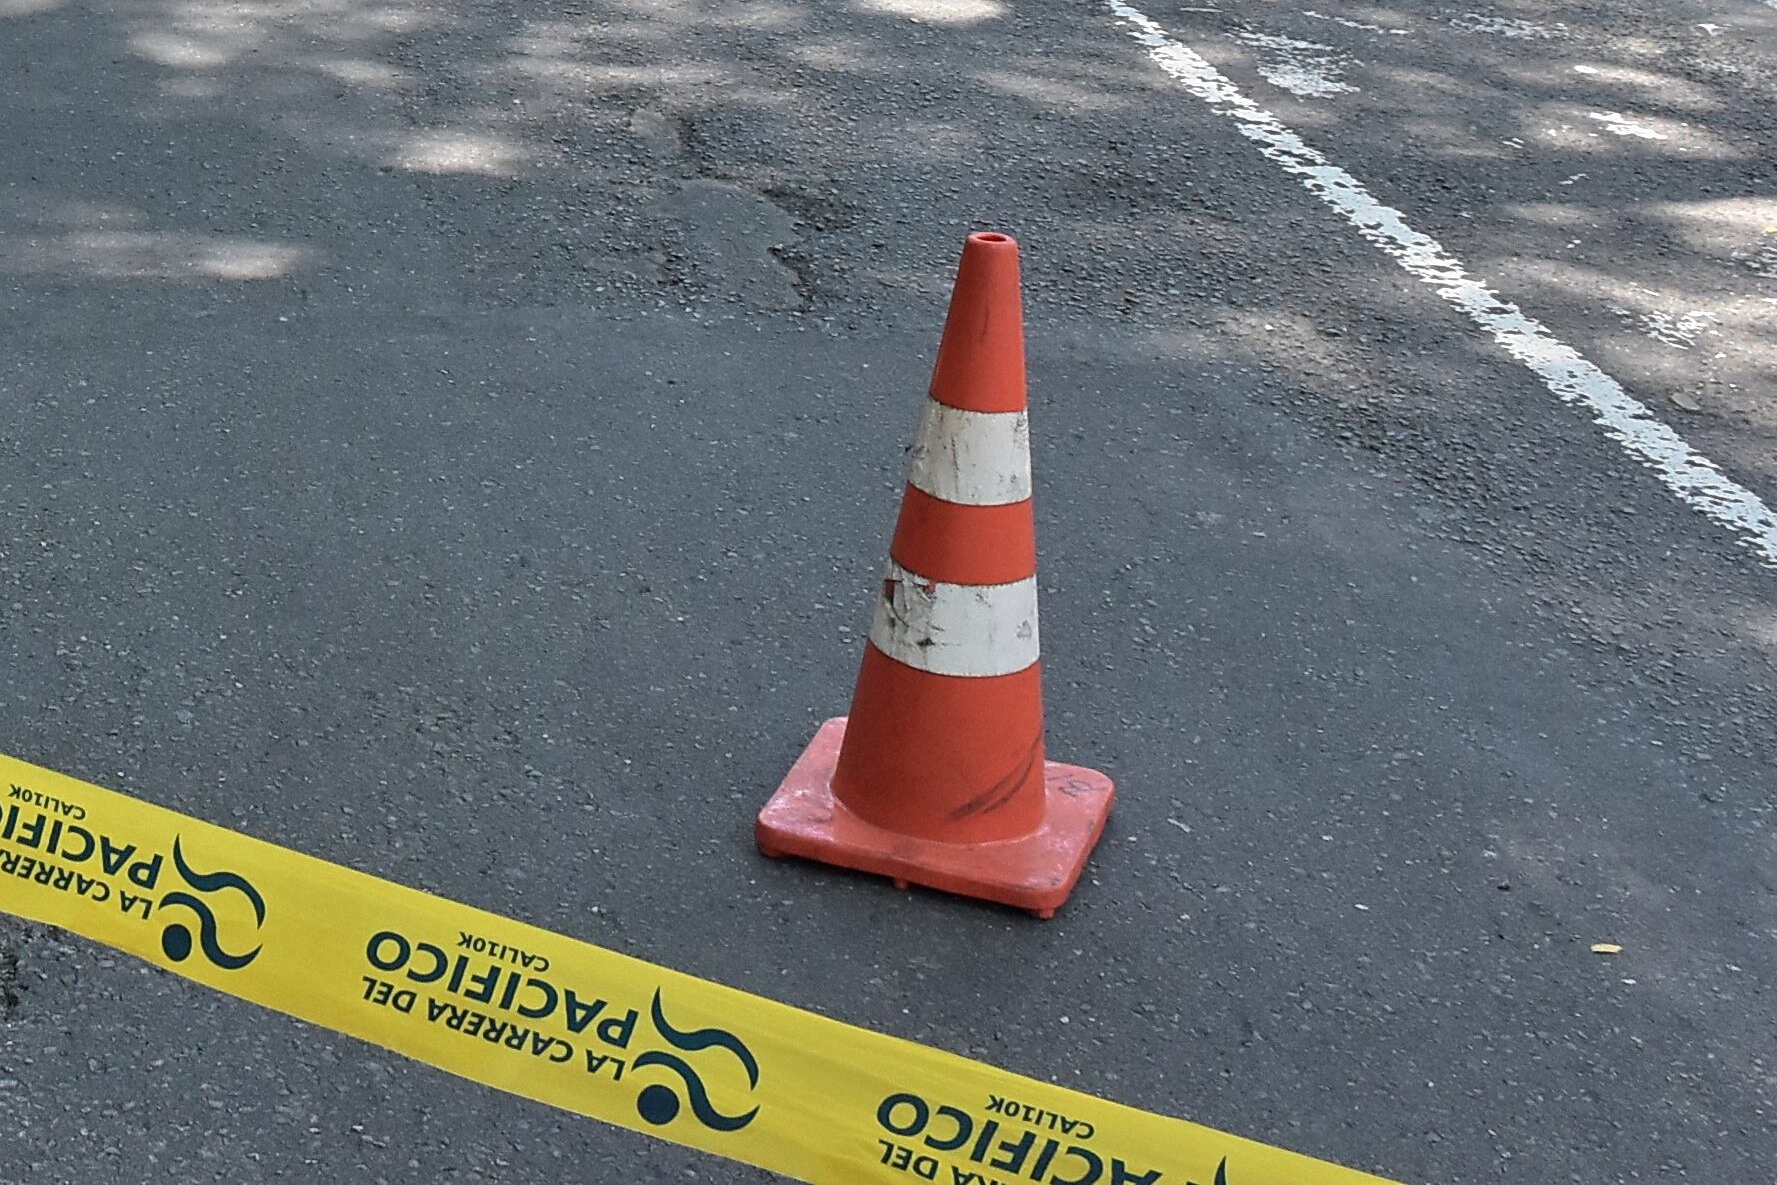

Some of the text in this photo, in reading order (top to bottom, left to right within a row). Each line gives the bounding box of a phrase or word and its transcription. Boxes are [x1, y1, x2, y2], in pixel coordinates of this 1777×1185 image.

[8, 784, 86, 821] CALI10K
[119, 890, 153, 920] LA
[456, 931, 550, 973] CALI10K
[366, 931, 639, 1050] PACIFICO
[362, 975, 626, 1082] LA CARRERA DEL
[876, 1092, 1199, 1185] ACIFICO
[984, 1094, 1095, 1140] CALI10K
[878, 1138, 939, 1181] DEL
